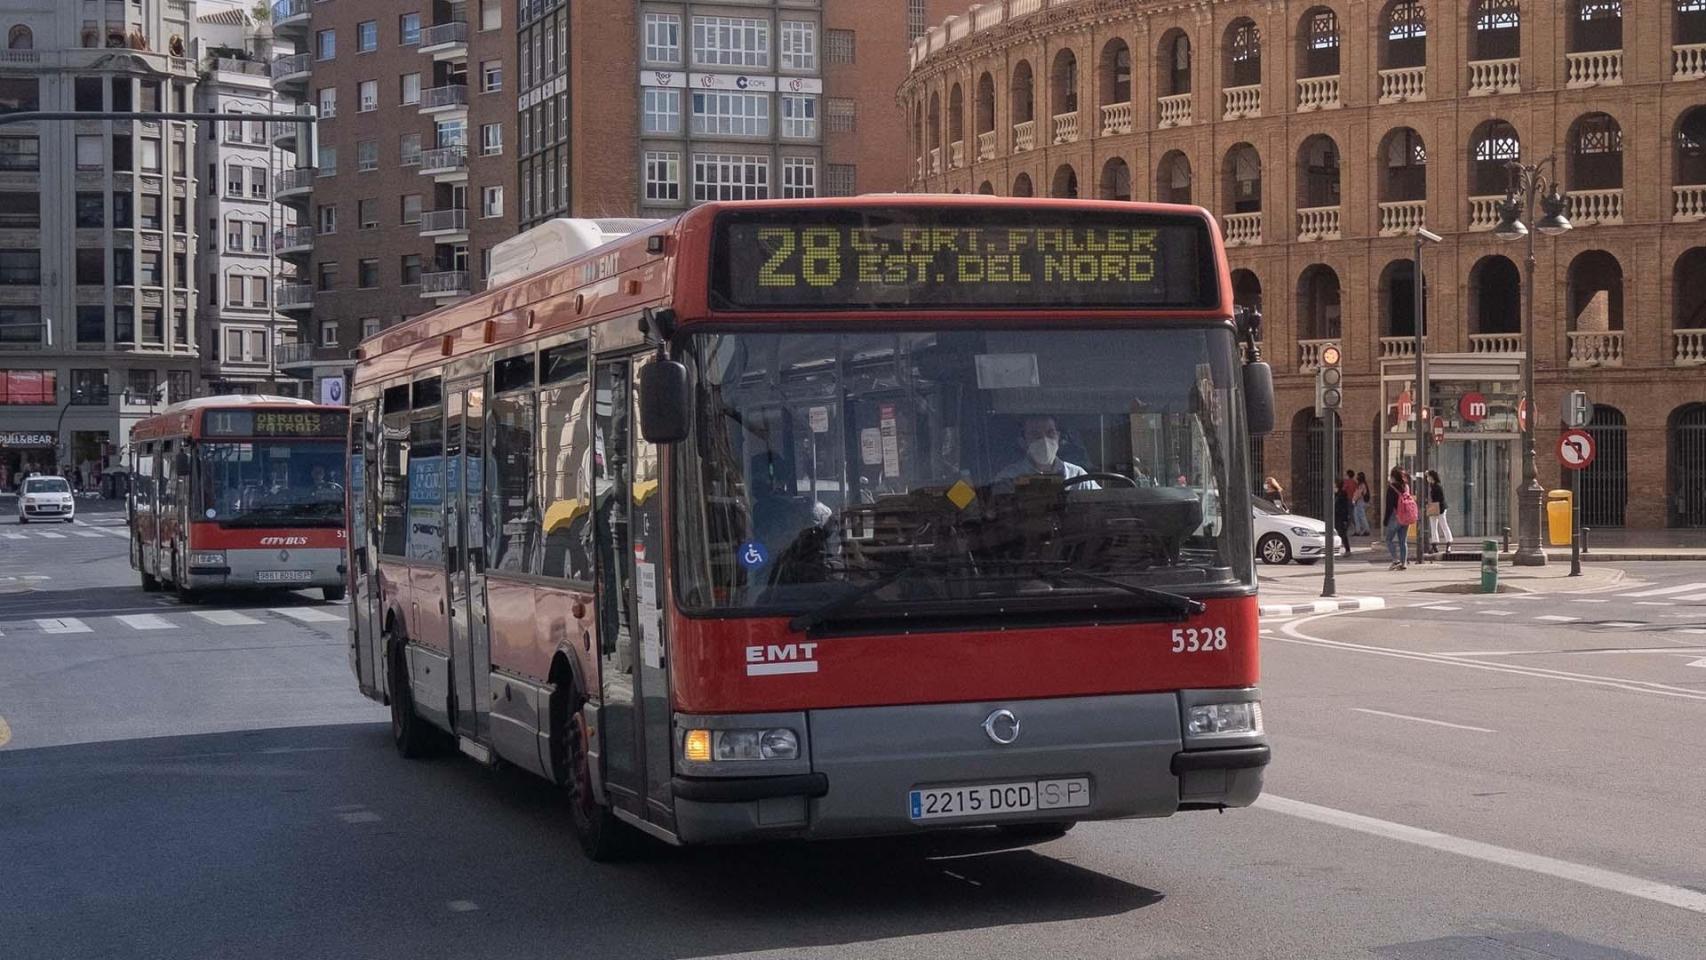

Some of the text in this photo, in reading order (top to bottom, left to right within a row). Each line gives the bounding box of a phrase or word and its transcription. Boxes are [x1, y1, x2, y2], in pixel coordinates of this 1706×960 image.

[903, 228, 996, 251] ART.
[1008, 228, 1160, 251] FALLER
[758, 228, 841, 286] 28
[859, 255, 1154, 282] EST. DEL NORD
[1470, 402, 1486, 416] m
[216, 414, 233, 432] 11
[257, 423, 321, 432] PATRAIX
[1172, 627, 1227, 653] 5328
[746, 643, 818, 662] EMT
[926, 790, 982, 814] 2215
[990, 787, 1031, 809] DCD
